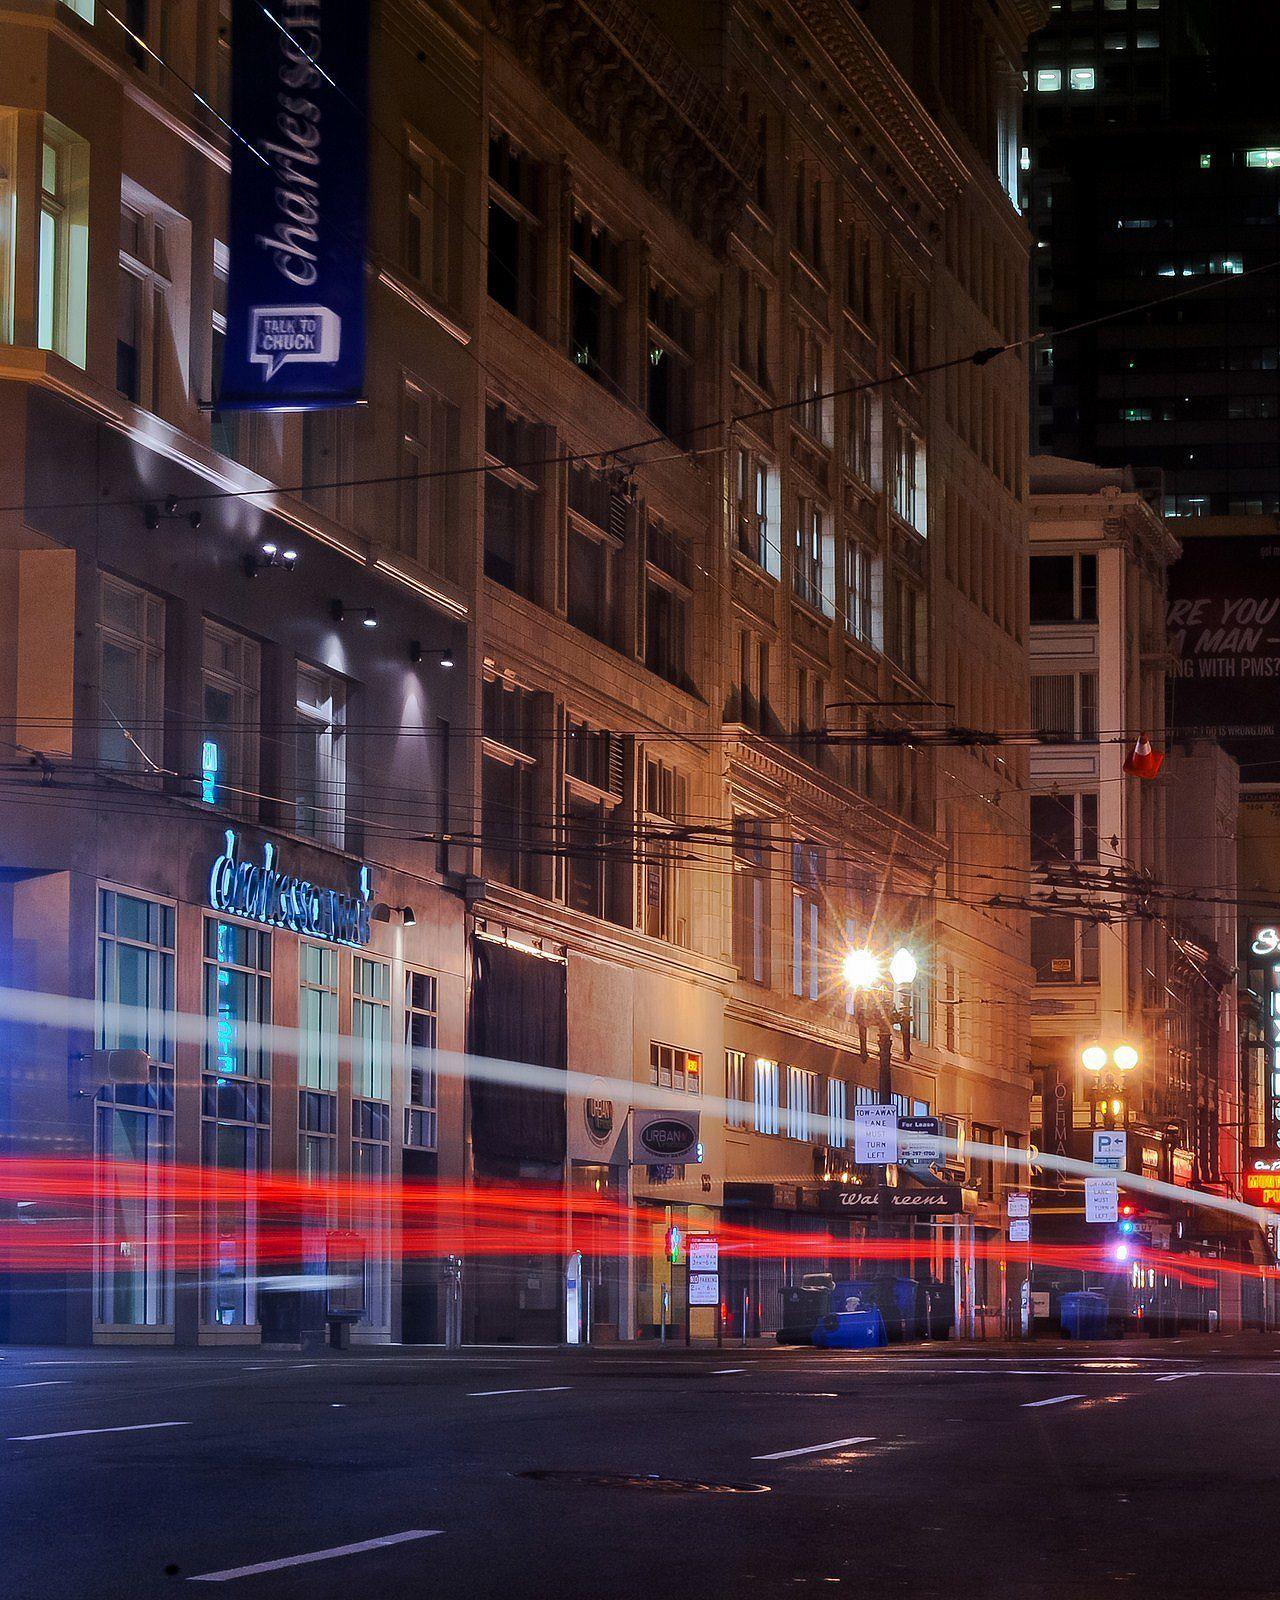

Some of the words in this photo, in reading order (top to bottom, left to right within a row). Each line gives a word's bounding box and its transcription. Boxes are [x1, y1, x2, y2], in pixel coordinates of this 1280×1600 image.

[255, 92, 321, 286] charles
[264, 319, 295, 334] TALK
[300, 319, 317, 333] TO
[262, 334, 315, 350] CHUCK
[1221, 597, 1280, 625] YOU
[1194, 626, 1264, 654] MAN
[1199, 656, 1236, 678] WITH
[1241, 656, 1280, 677] PMS?
[856, 1109, 896, 1117] TOW-AWAY
[645, 1128, 681, 1148] URBAN
[1098, 1136, 1112, 1152] P
[867, 1151, 885, 1159] LEFT
[838, 1192, 948, 1206] Walreens
